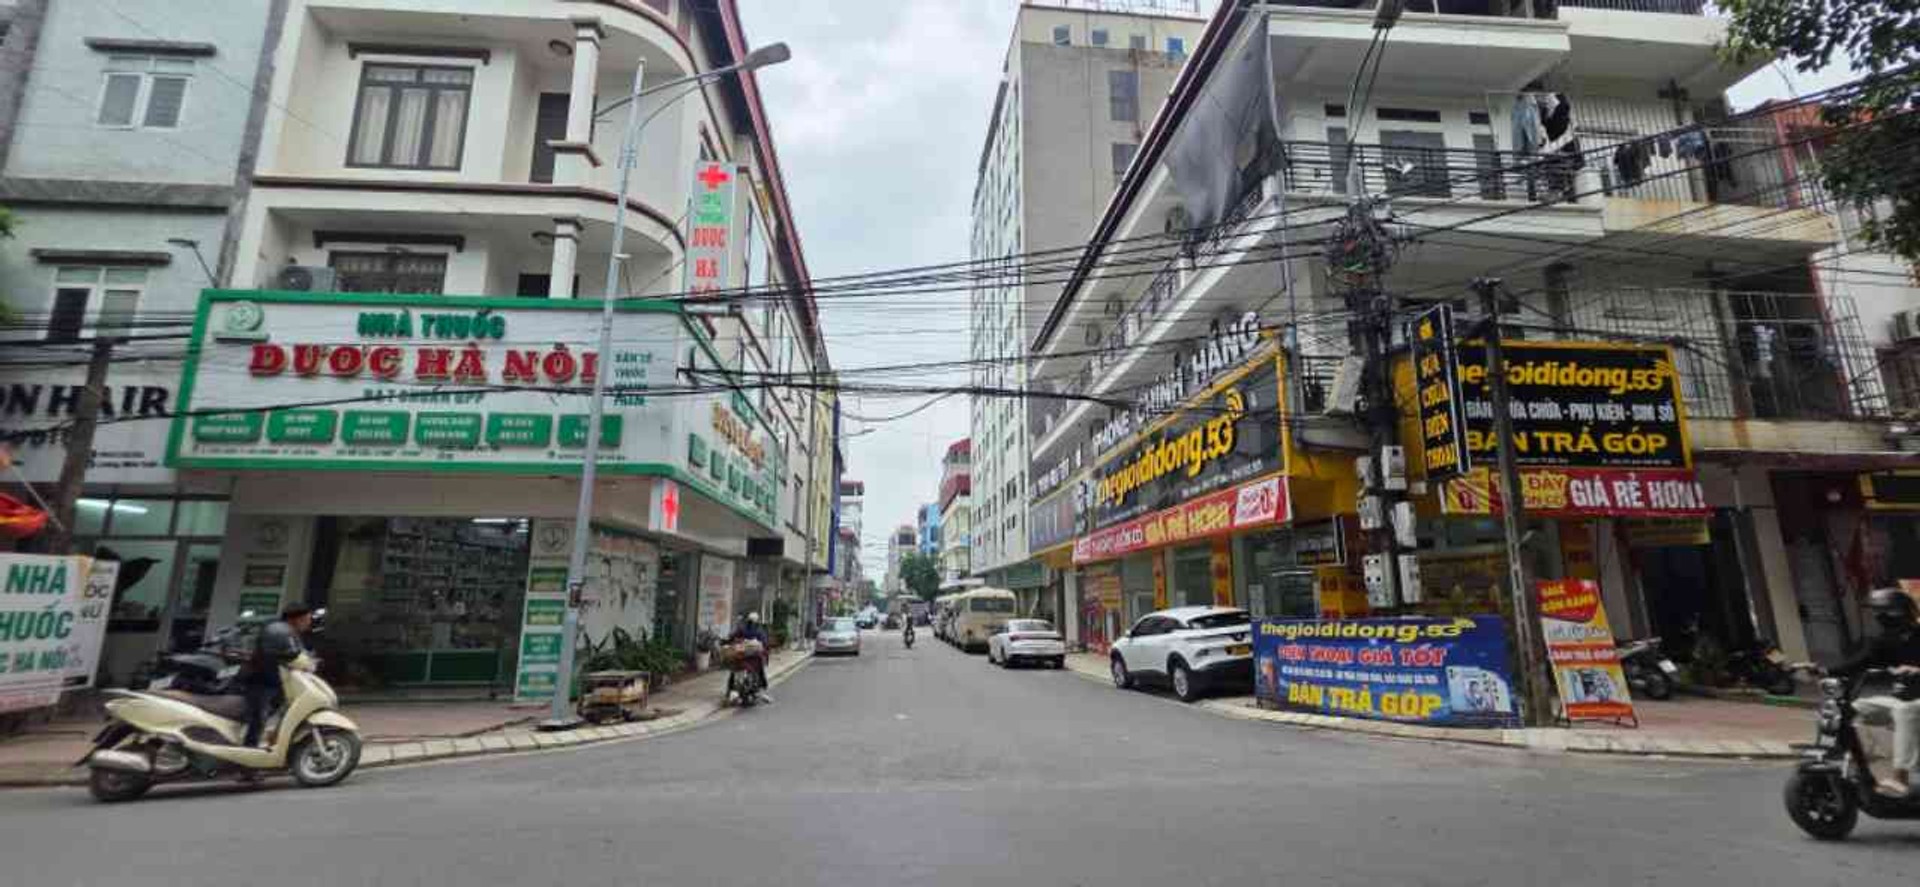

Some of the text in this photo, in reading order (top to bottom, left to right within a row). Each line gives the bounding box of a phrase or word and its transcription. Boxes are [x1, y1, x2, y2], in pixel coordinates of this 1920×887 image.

[357, 306, 506, 339] NHÀ THUỐC
[415, 342, 487, 384] HÀ
[502, 342, 600, 384] NỘI
[1532, 425, 1598, 453] TRẢ
[1602, 425, 1669, 455] GÓP
[1570, 476, 1609, 507] GIÁ
[1614, 473, 1644, 507] RẺ
[5, 560, 68, 594] NHÀ
[0, 600, 73, 641] HUỐC
[1260, 621, 1461, 643] thegioididong.5G
[1358, 645, 1394, 666] GIÁ
[1402, 644, 1448, 667] TỐT
[1289, 682, 1442, 717] BÁN TRẢ GÓP
